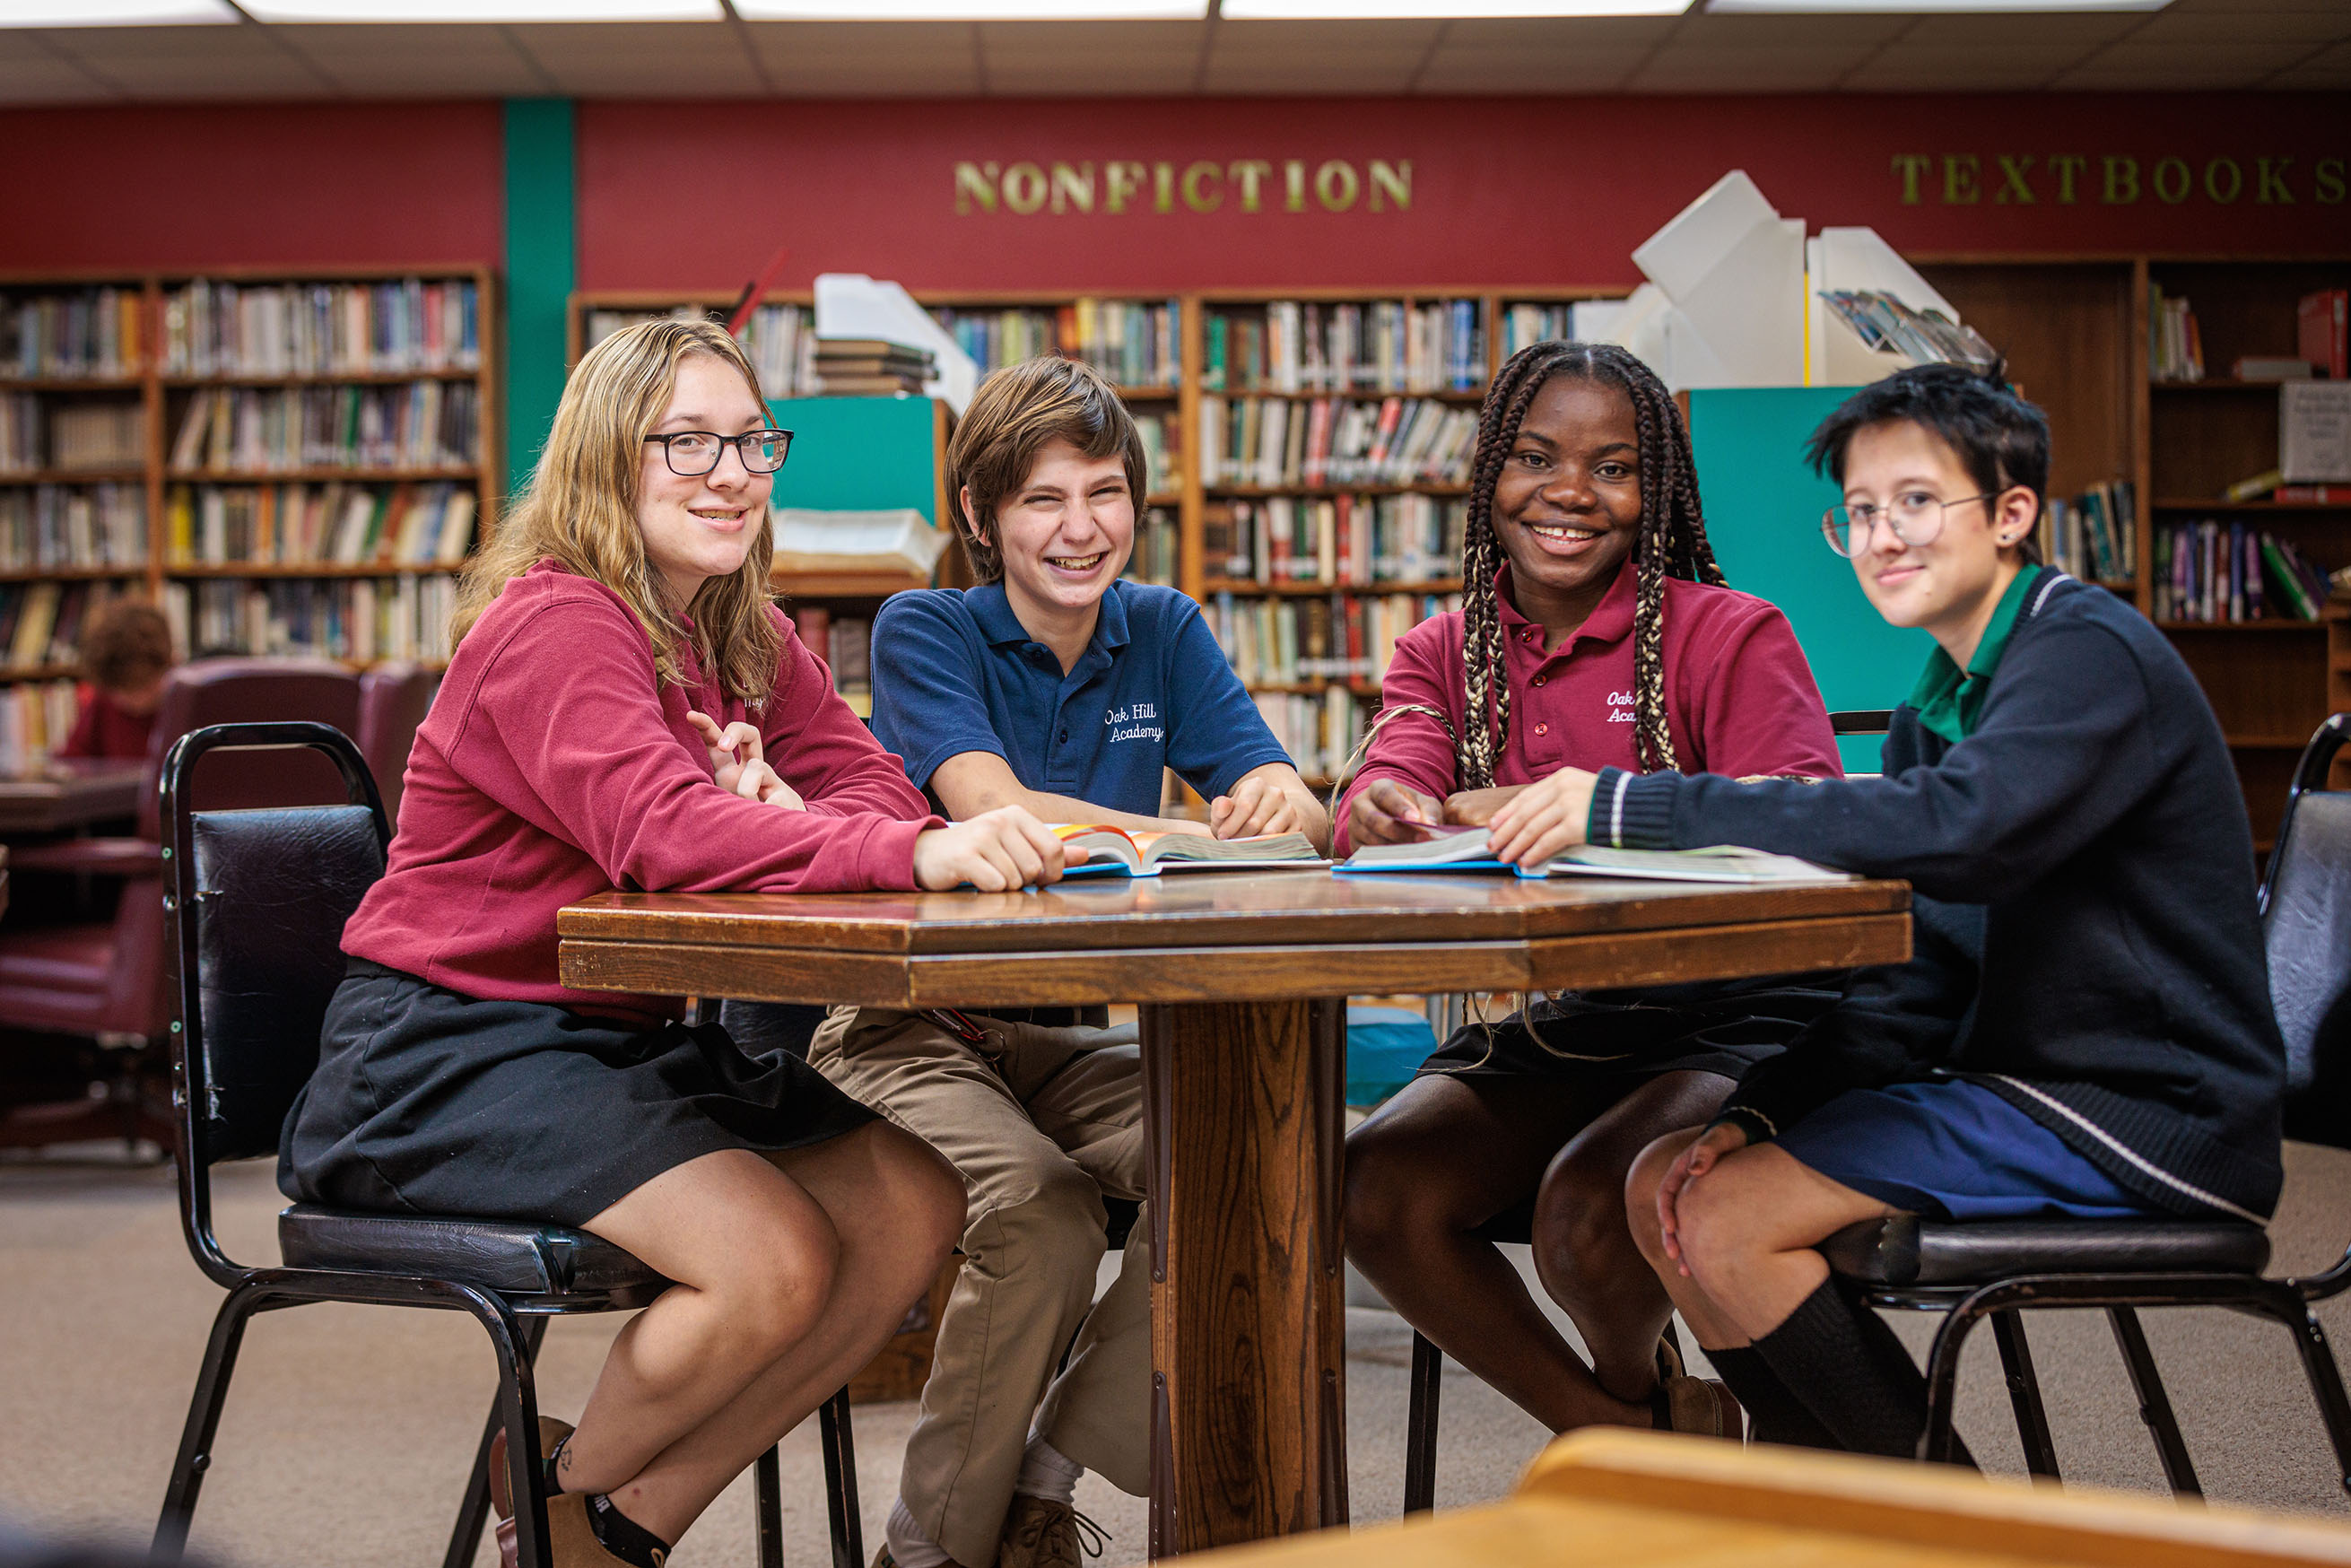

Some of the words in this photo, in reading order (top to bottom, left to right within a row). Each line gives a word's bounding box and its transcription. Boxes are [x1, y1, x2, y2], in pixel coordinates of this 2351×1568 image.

[954, 160, 1414, 214] NONFICTION
[1892, 154, 2347, 205] TEXTBOOKS
[1607, 690, 1635, 705] Oak
[1104, 707, 1129, 725] Oak
[1132, 702, 1156, 719] Hill
[1110, 723, 1164, 743] Academy
